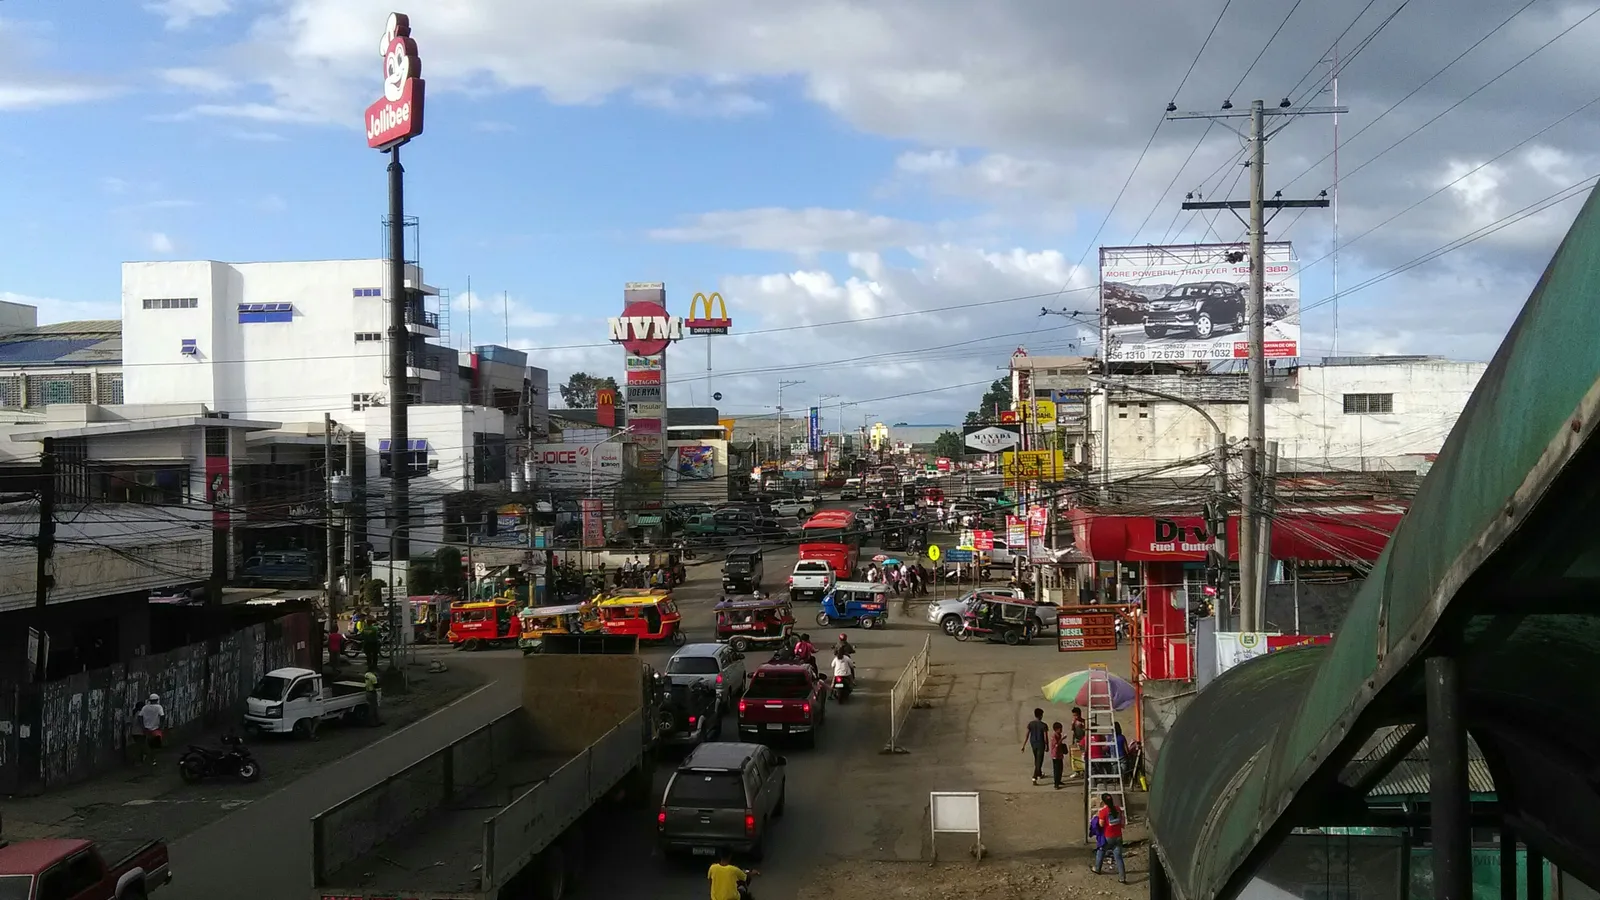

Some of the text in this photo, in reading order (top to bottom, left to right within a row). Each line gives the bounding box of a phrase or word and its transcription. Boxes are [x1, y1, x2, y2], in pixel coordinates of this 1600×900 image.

[368, 102, 410, 139] Jollibee
[1205, 267, 1227, 275] EVER
[608, 316, 683, 340] NVM
[1126, 351, 1145, 359] 1310
[1152, 350, 1184, 359] 72 6739
[1192, 349, 1230, 358] 707 1032
[641, 387, 660, 396] RYAN
[1150, 543, 1175, 551] Fuel
[1060, 617, 1082, 625] PREMIUM
[1061, 628, 1083, 636] DIESEL
[1061, 639, 1084, 647] KEROSENE
